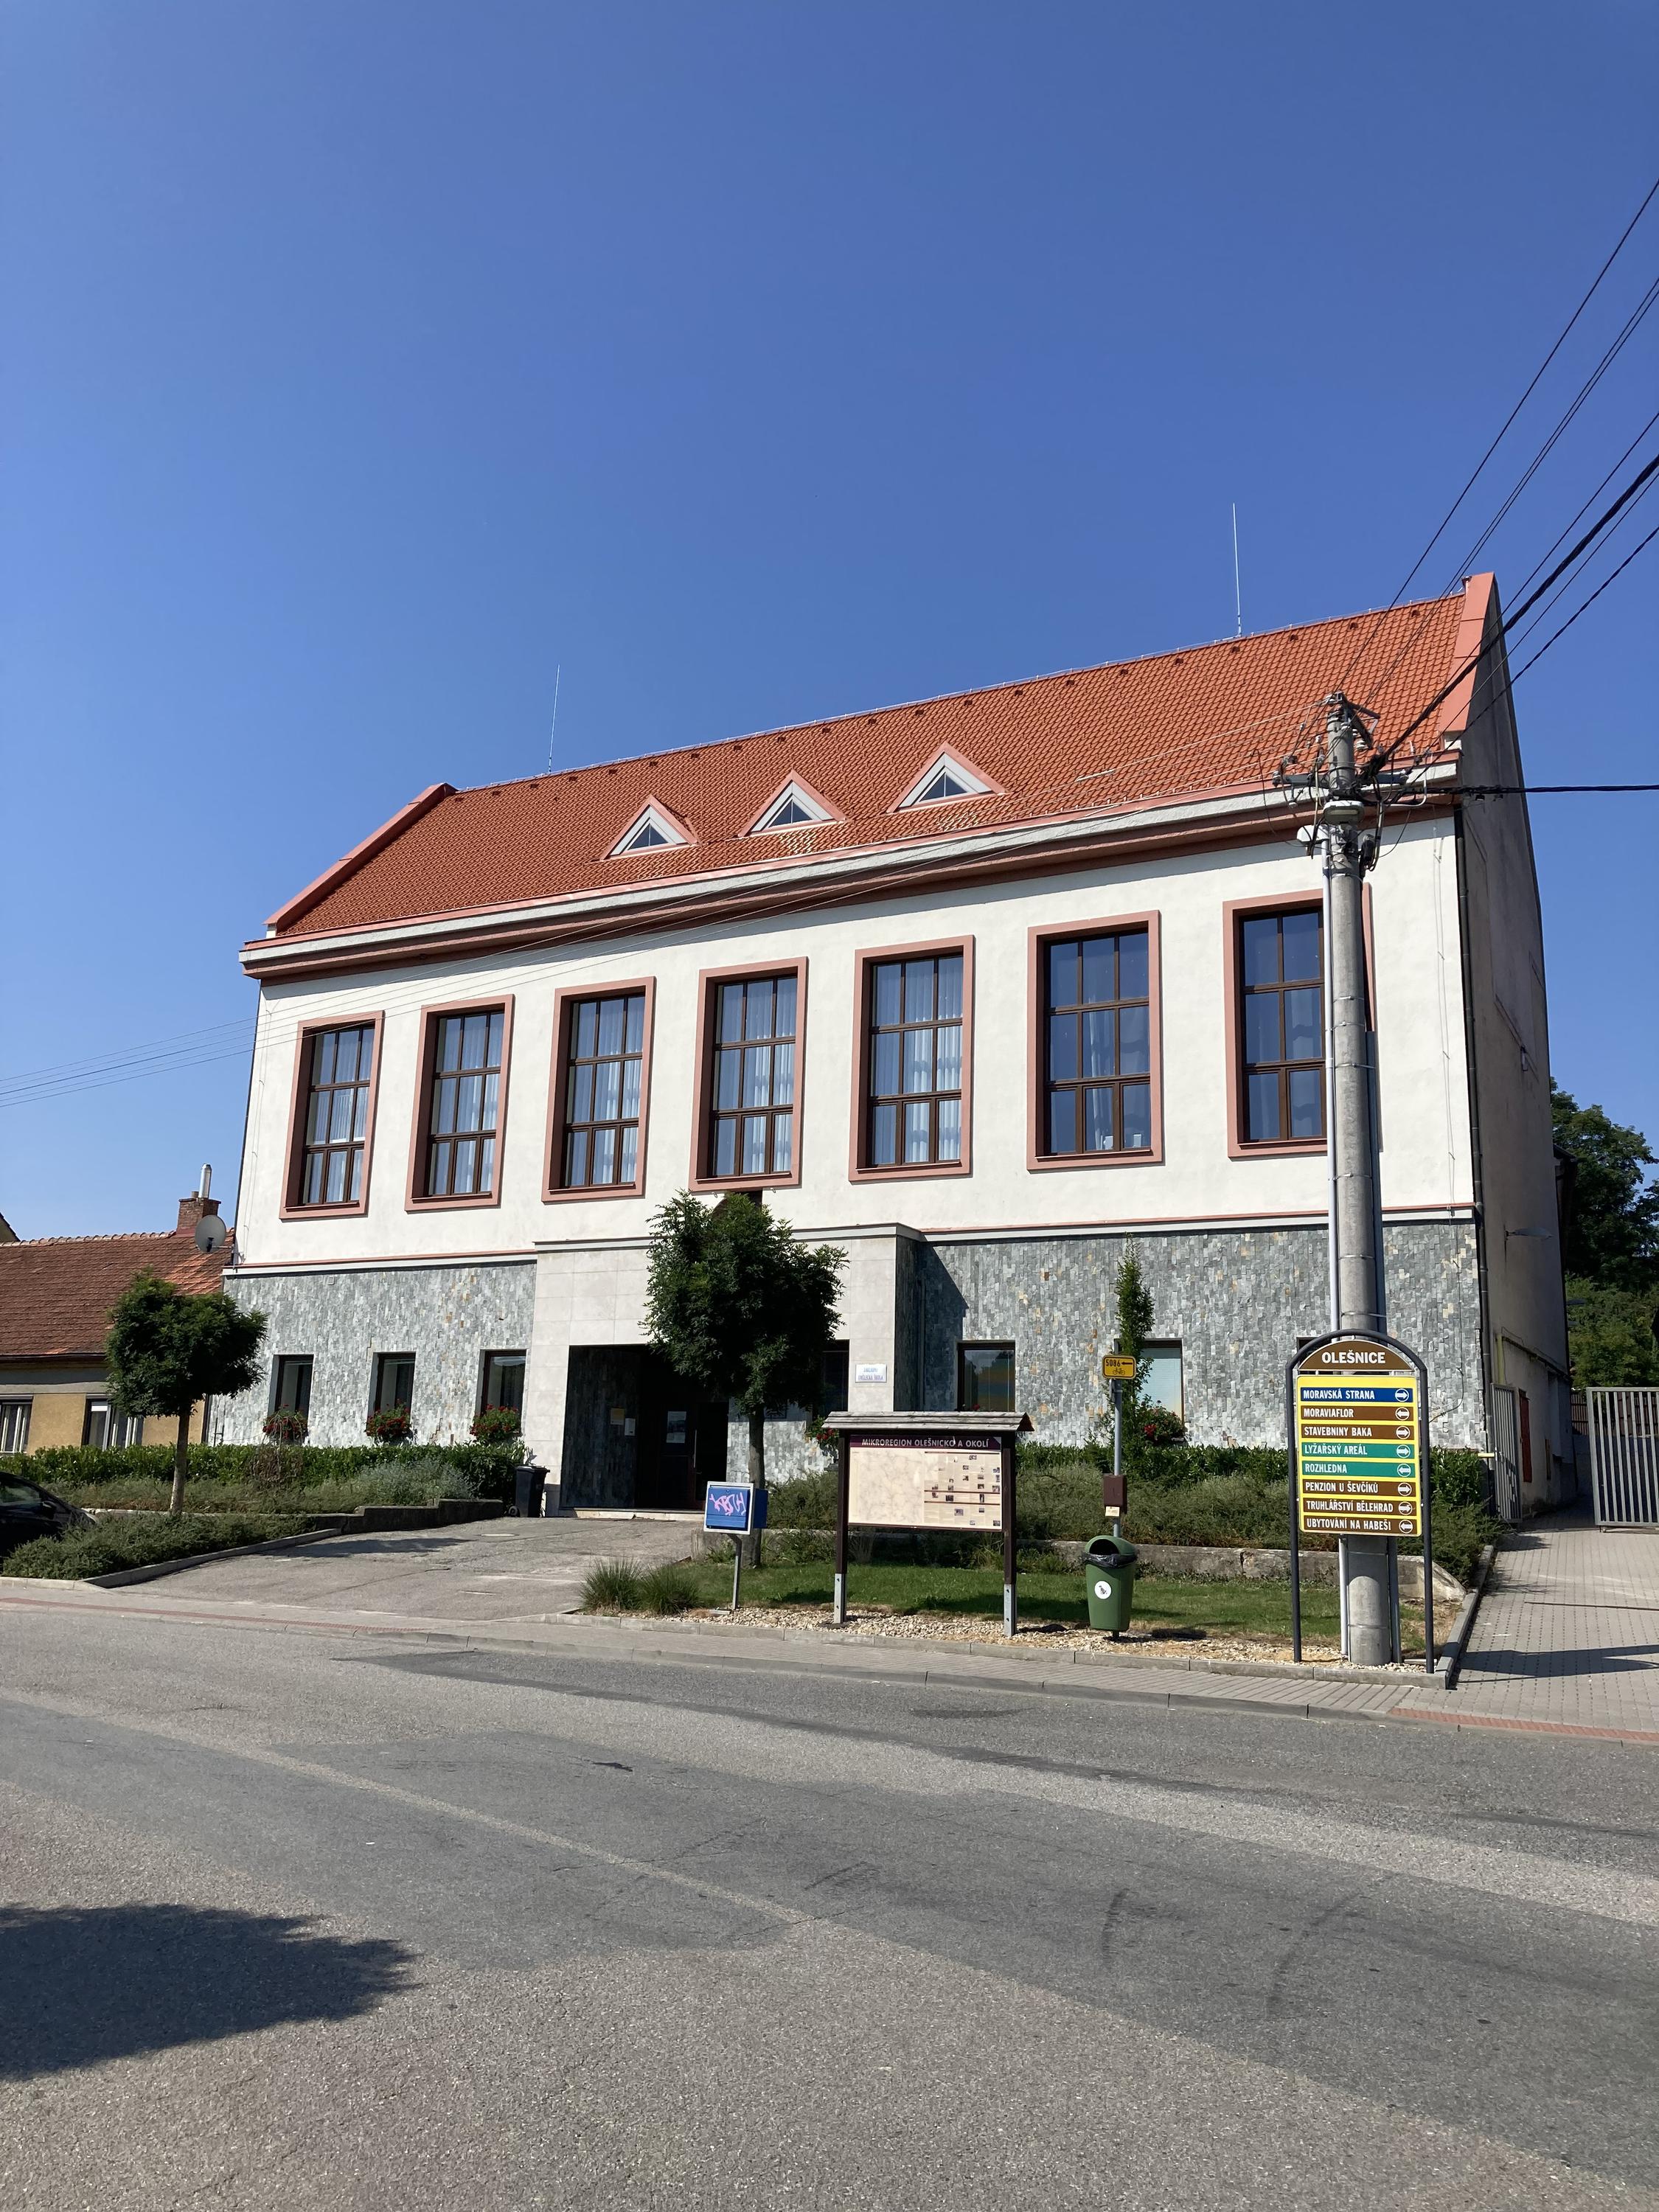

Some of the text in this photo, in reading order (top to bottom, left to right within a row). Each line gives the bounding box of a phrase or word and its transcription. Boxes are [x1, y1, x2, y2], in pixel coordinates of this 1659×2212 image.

[1321, 1349, 1386, 1364] OLEŠNICE
[1105, 1359, 1121, 1367] 5086
[1303, 1388, 1375, 1399] MORAVSKÁ STRANA
[1304, 1408, 1354, 1418] MORAVIAFLOR
[1304, 1426, 1372, 1437] STAVEBNINY BAKA
[861, 1437, 990, 1448] MIKROREGION OLEŠNICKO A OKOLÍ
[1304, 1443, 1368, 1455] LYŽAŘSKÝ AREÁL
[1304, 1463, 1348, 1473] ROZHLEDNA
[1305, 1481, 1378, 1493] PENZION U ŠEVČÍKŮ
[1306, 1499, 1394, 1512] TRUHLÁŘSTVÍ BĚLEHRAD
[1307, 1517, 1391, 1531] UBYTOVÁNÍ NA HABEŠI
